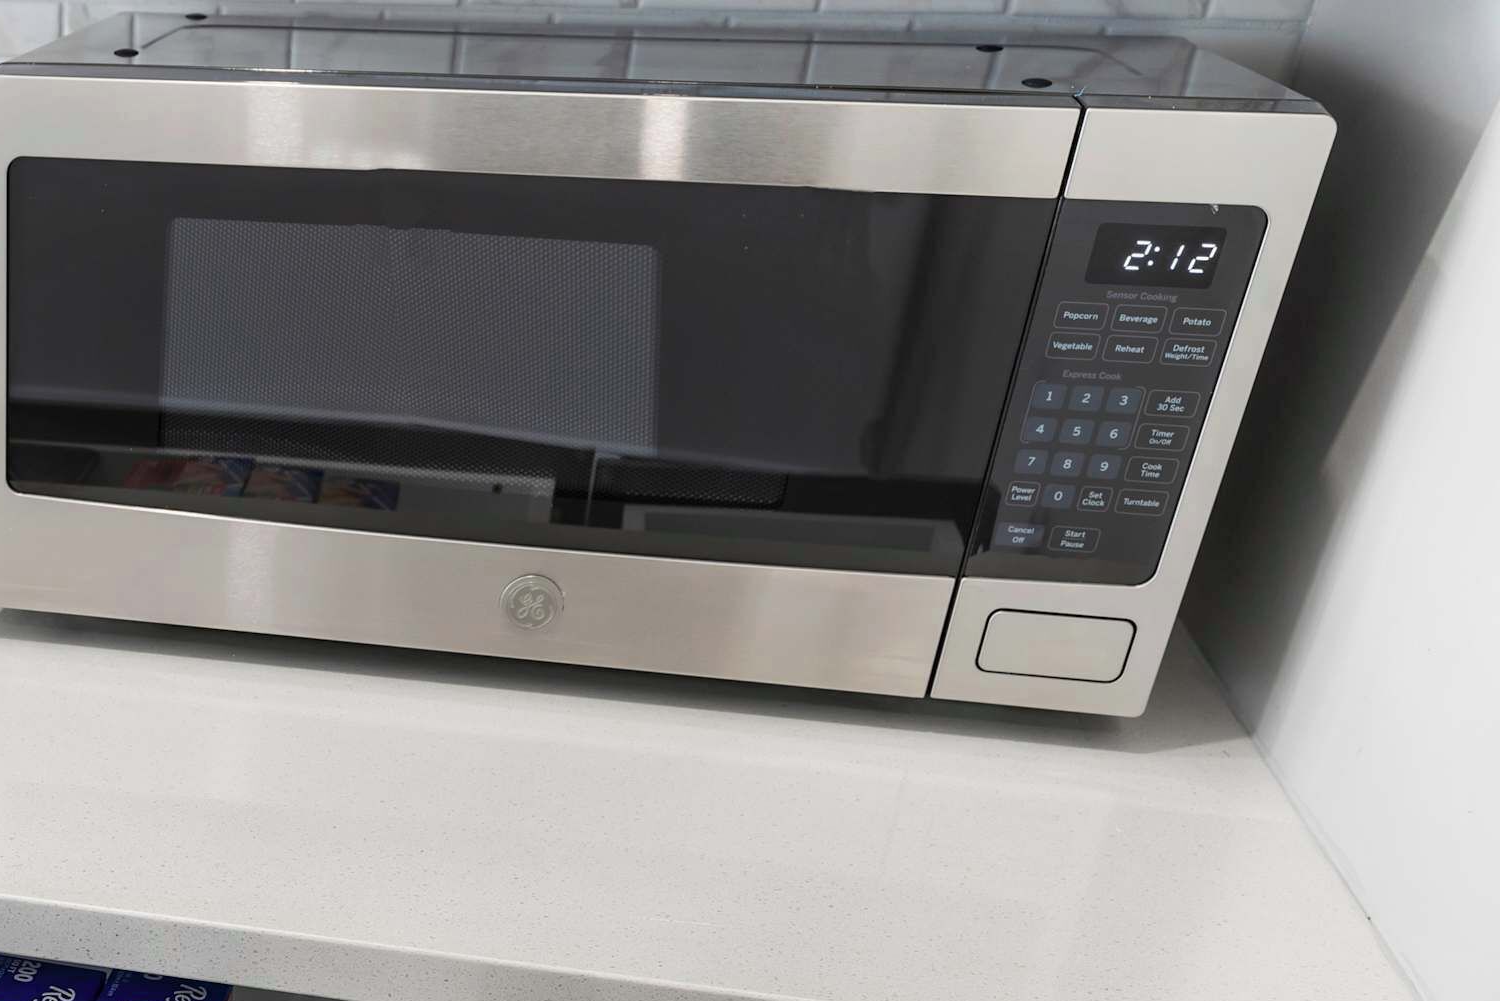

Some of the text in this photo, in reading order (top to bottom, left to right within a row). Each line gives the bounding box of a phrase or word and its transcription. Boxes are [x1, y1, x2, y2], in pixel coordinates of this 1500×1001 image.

[1123, 240, 1218, 274] 2:12
[1106, 290, 1178, 303] Sensor Cooking
[1063, 311, 1098, 321] Popcorn
[1119, 314, 1158, 324] Beverage
[1183, 317, 1211, 327] Potato
[1053, 341, 1093, 352] Vegetable
[1115, 344, 1144, 354] Reheat
[1172, 344, 1205, 354] Defrost
[1164, 352, 1208, 362] Weight/Time
[1062, 369, 1122, 381] Express Cook
[1046, 391, 1053, 401] 1
[1082, 393, 1091, 404] 2
[1119, 395, 1128, 406] 3
[1164, 396, 1182, 404] Add
[1156, 404, 1185, 413] 30 Sec
[1035, 424, 1044, 434] 4
[1072, 427, 1081, 437] 5
[1109, 429, 1118, 439] 6
[1151, 429, 1175, 438] Timer
[1148, 437, 1172, 446] On/Off
[1028, 456, 1036, 467] 7
[1063, 459, 1072, 469] 8
[1100, 461, 1109, 472] 9
[1141, 462, 1162, 471] Cook
[1140, 470, 1160, 479] Time
[1011, 486, 1036, 495] Power
[1088, 490, 1103, 500] Set
[1011, 493, 1032, 502] Level
[1054, 491, 1063, 501] 0
[1082, 498, 1104, 507] Clock
[1123, 497, 1160, 508] Turntable
[1008, 526, 1035, 535] Cancel
[1064, 529, 1086, 539] Start
[1012, 535, 1025, 544] Off
[1060, 540, 1084, 549] Pause
[13, 960, 42, 982] 200
